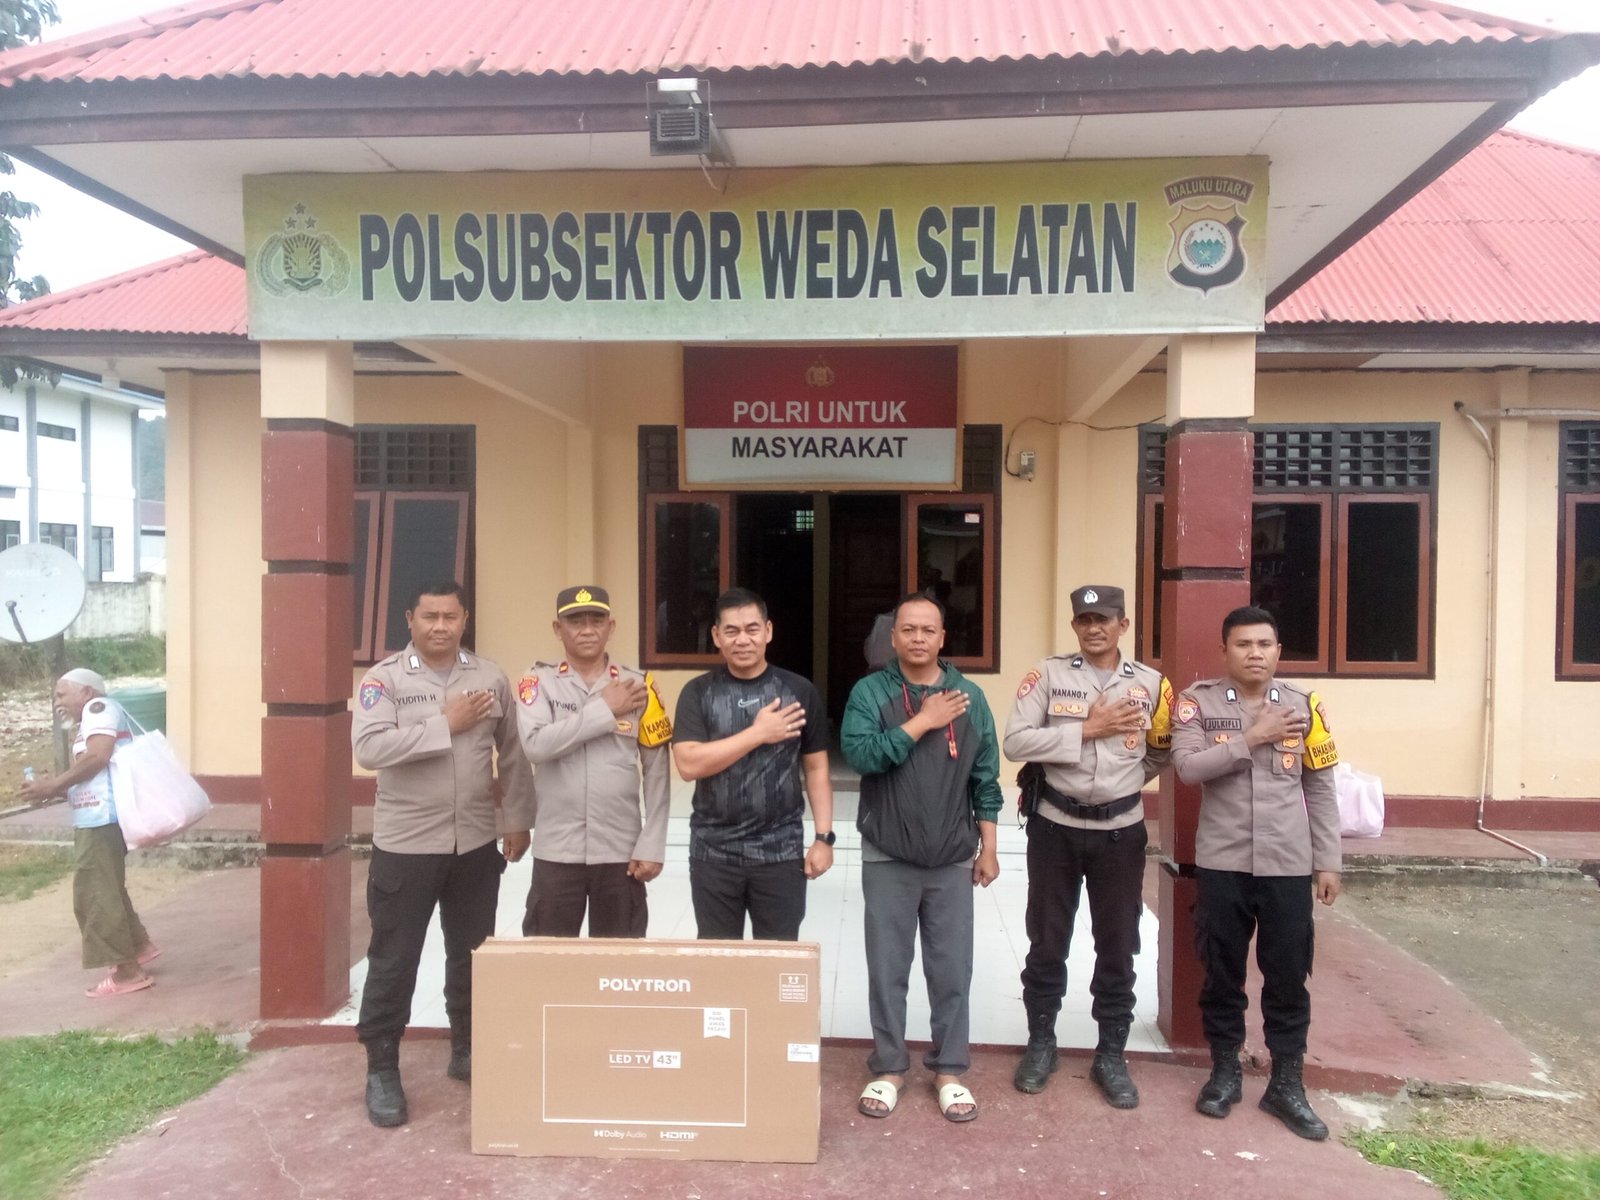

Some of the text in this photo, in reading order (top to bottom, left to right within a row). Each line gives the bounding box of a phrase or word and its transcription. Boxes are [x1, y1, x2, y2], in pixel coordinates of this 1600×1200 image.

[1169, 180, 1248, 200] MALUKU UTARA
[359, 202, 1137, 302] POLSUBSEKTOR WEDA SELATAN
[733, 401, 907, 423] POLRI UNTUK
[732, 436, 908, 458] MASYARAKAT
[396, 693, 437, 706] YUDITH H
[599, 977, 691, 993] POLYTRON
[609, 1053, 678, 1065] LED TV 43"
[604, 1129, 648, 1140] Dolby Audio
